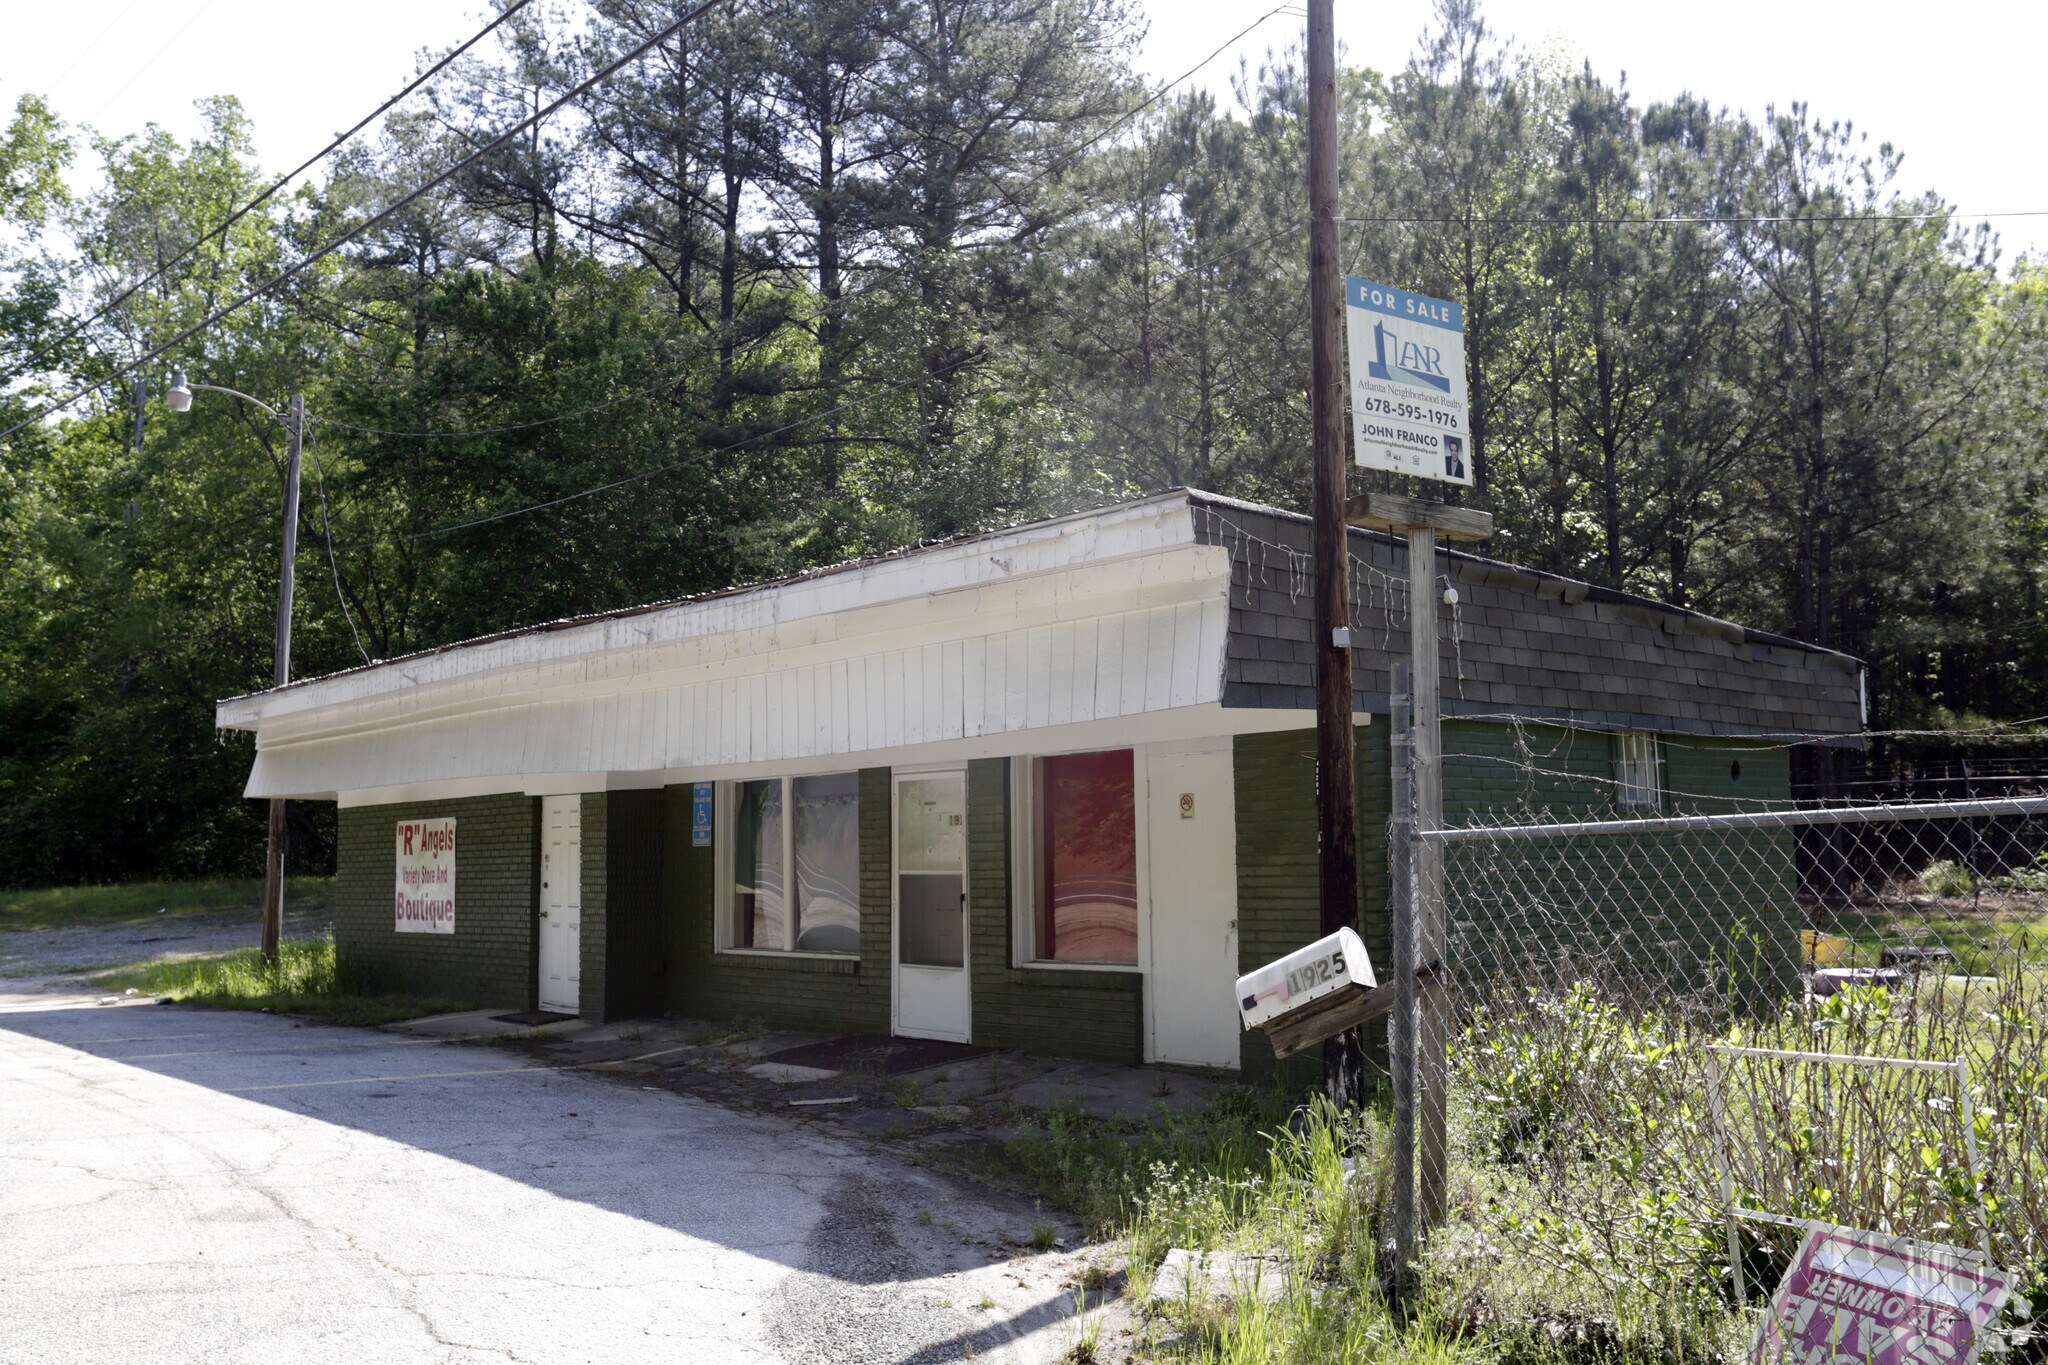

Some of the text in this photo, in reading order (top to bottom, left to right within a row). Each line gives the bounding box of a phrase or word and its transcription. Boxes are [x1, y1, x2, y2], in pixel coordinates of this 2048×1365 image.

[1360, 286, 1449, 323] FOR SALE
[1358, 380, 1463, 412] Atlanta Neighborhood Realty
[1365, 397, 1458, 428] 678-595-1976
[1362, 423, 1438, 447] JOHN FRANCO
[398, 822, 453, 859] "R" Angels
[402, 865, 448, 889] Variety Store And
[397, 891, 453, 929] Boutique
[1289, 952, 1346, 994] 1925
[1809, 1274, 1906, 1319] OWNER
[1783, 1293, 1958, 1365] SALE
